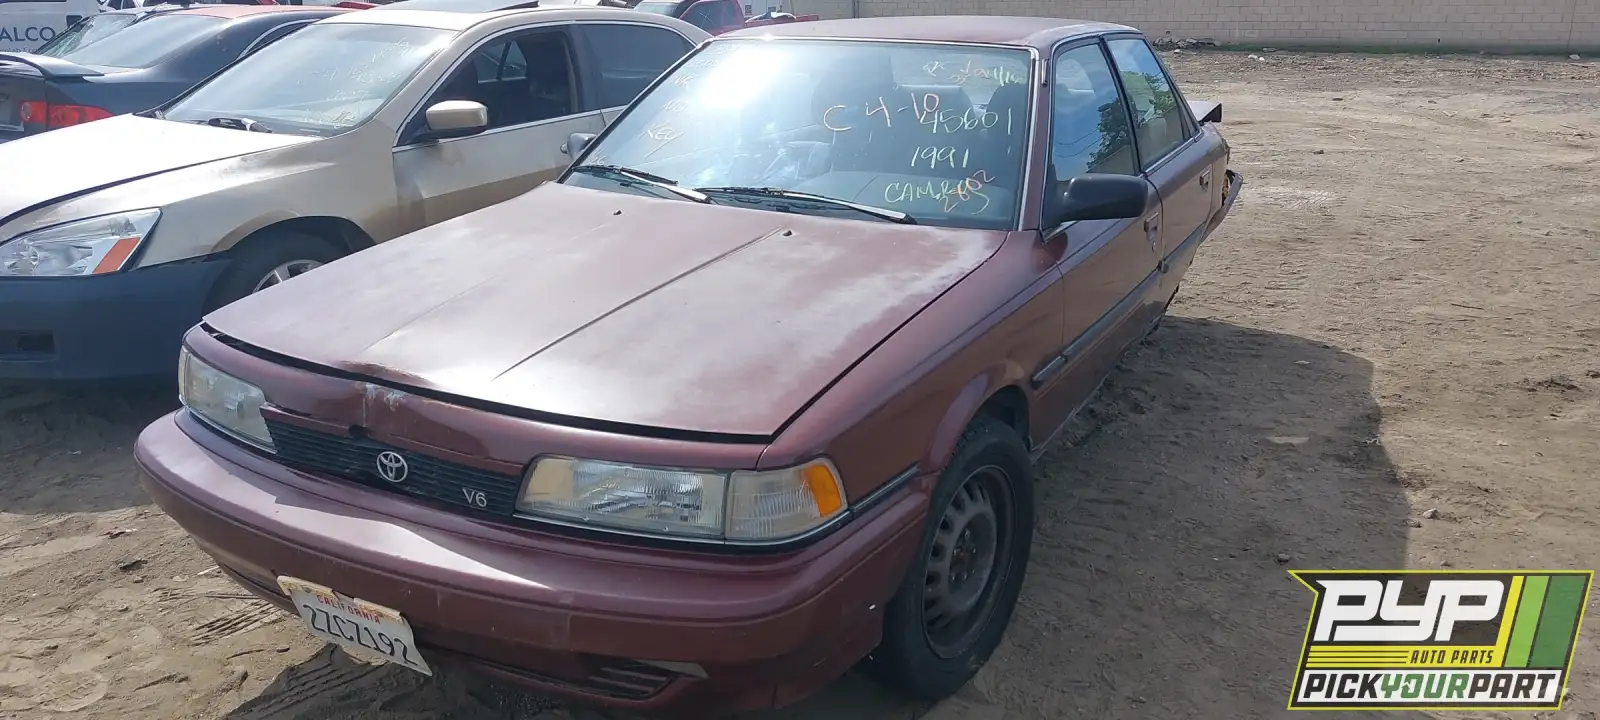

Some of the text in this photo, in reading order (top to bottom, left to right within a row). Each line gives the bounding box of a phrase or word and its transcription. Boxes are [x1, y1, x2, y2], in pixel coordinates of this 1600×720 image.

[0, 26, 56, 41] ALCO
[919, 107, 1012, 136] 45601
[910, 146, 969, 169] 1991
[462, 487, 487, 508] V6
[316, 594, 380, 625] CALIFORNIA
[302, 604, 418, 666] 2ZCZ192
